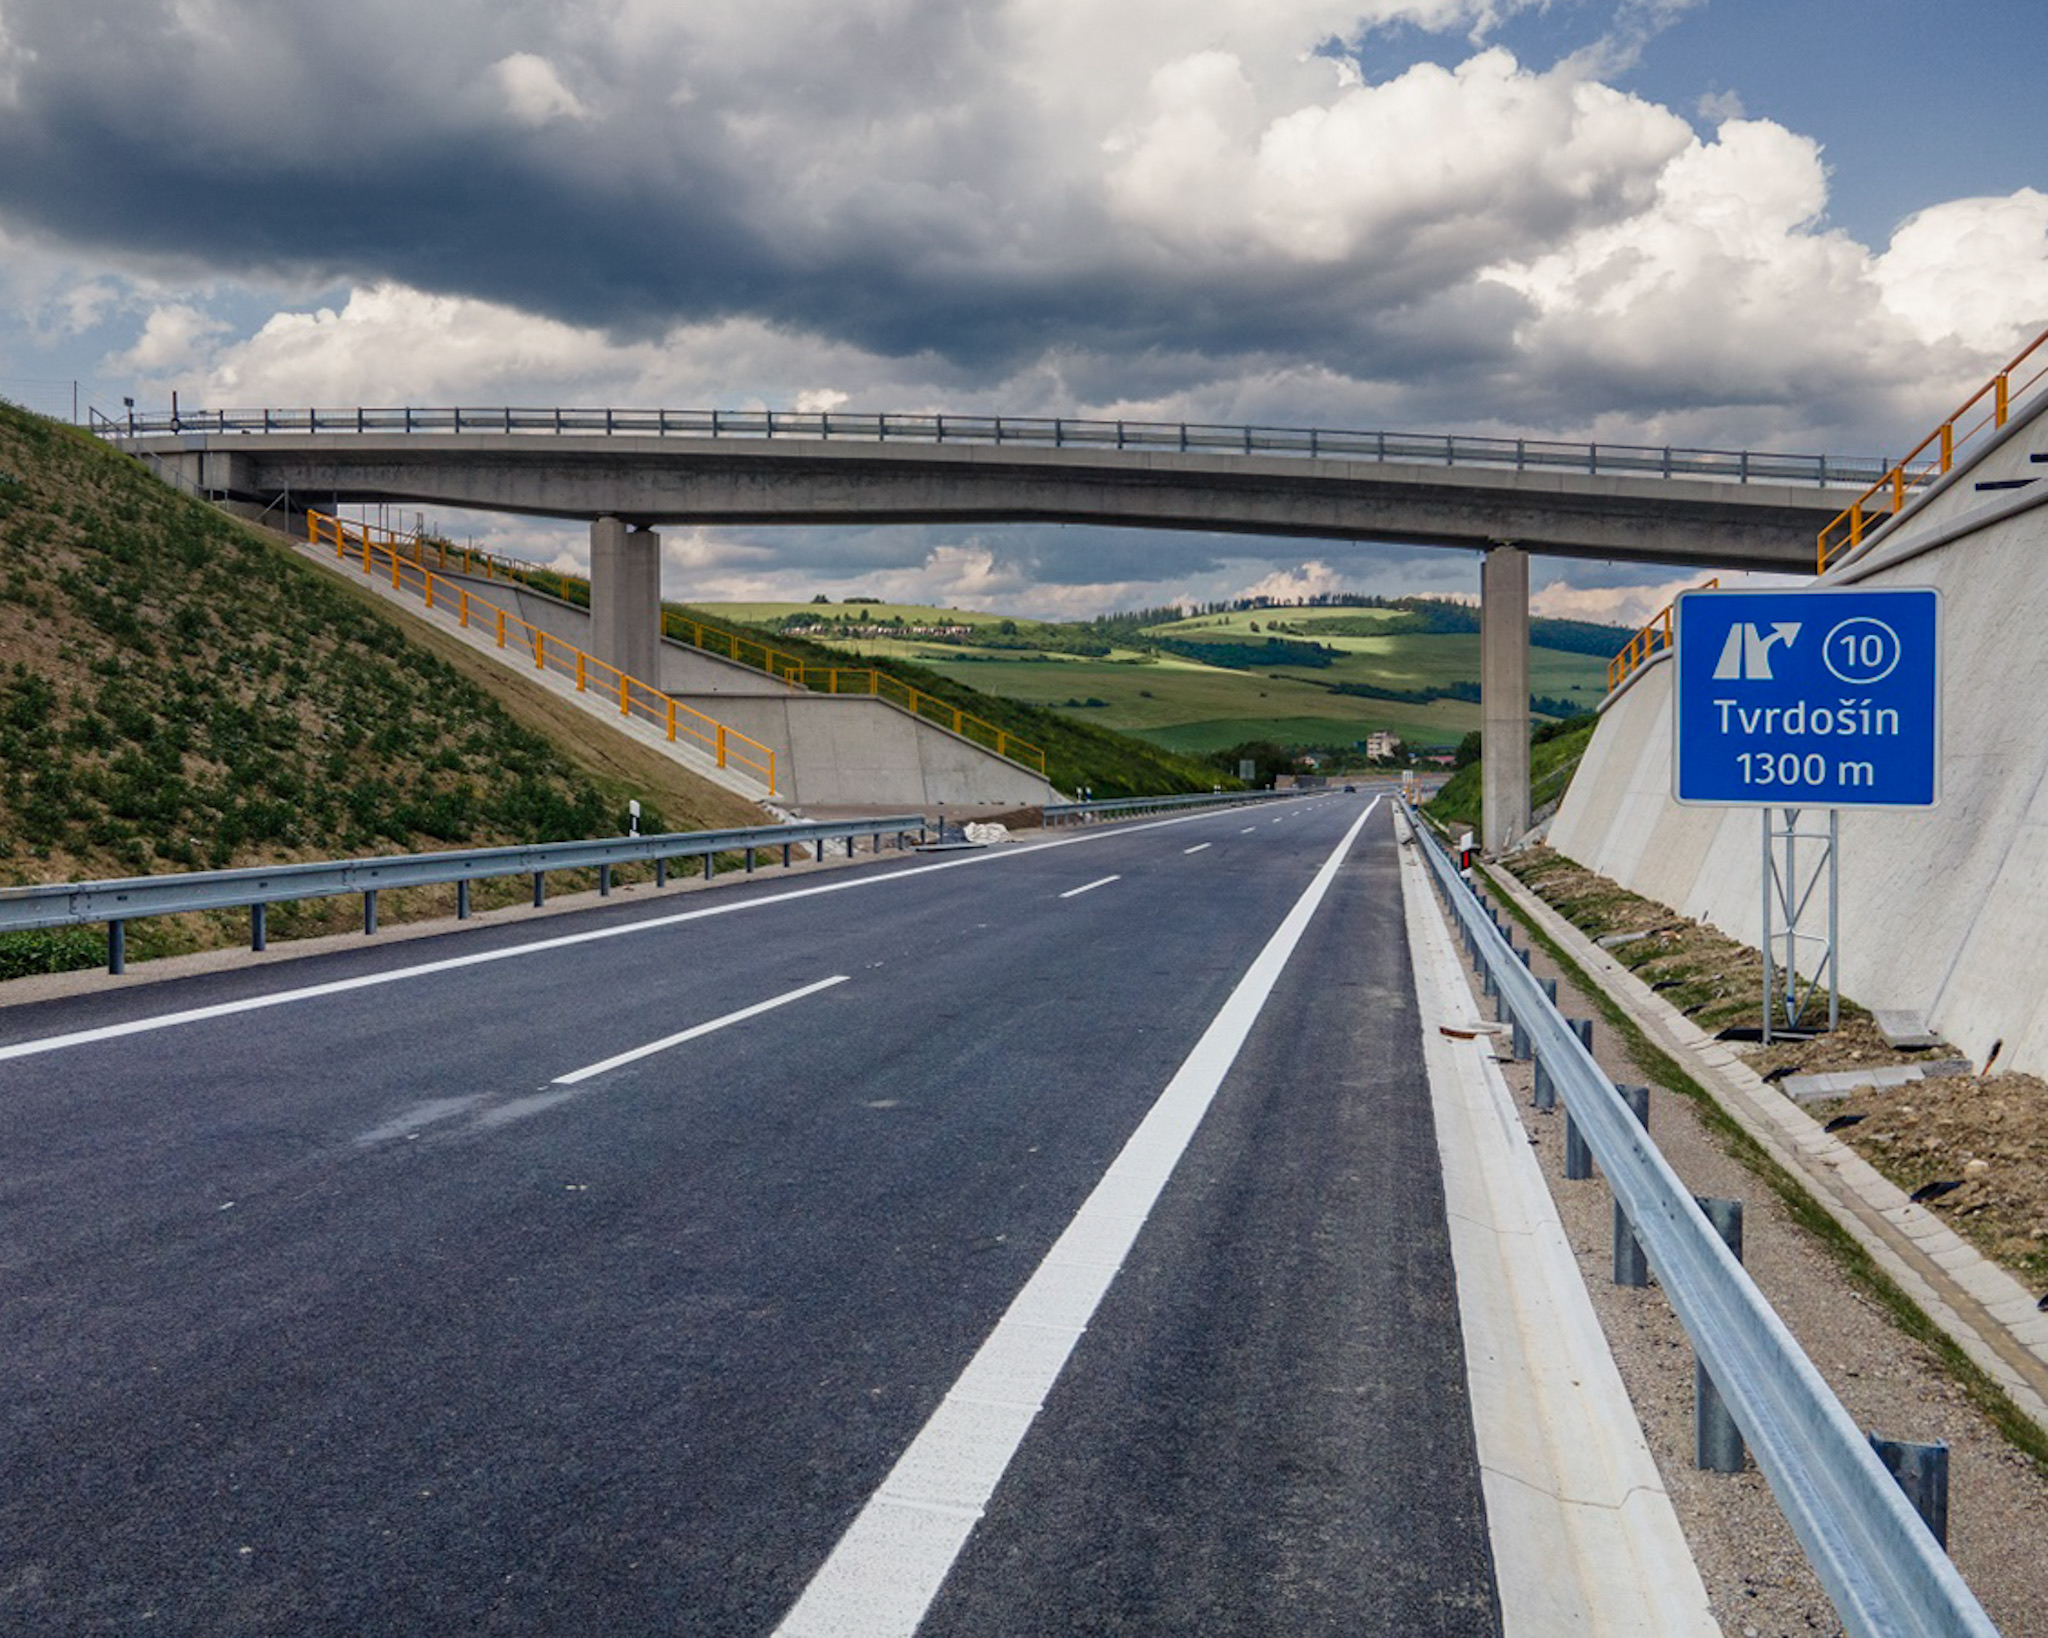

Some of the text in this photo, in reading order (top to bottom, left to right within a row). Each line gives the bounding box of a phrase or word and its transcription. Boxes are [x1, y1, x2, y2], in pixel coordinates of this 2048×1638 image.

[1840, 634, 1884, 667] 10
[1713, 699, 1899, 735] Tvrdošín
[1736, 753, 1874, 786] 1300 m
